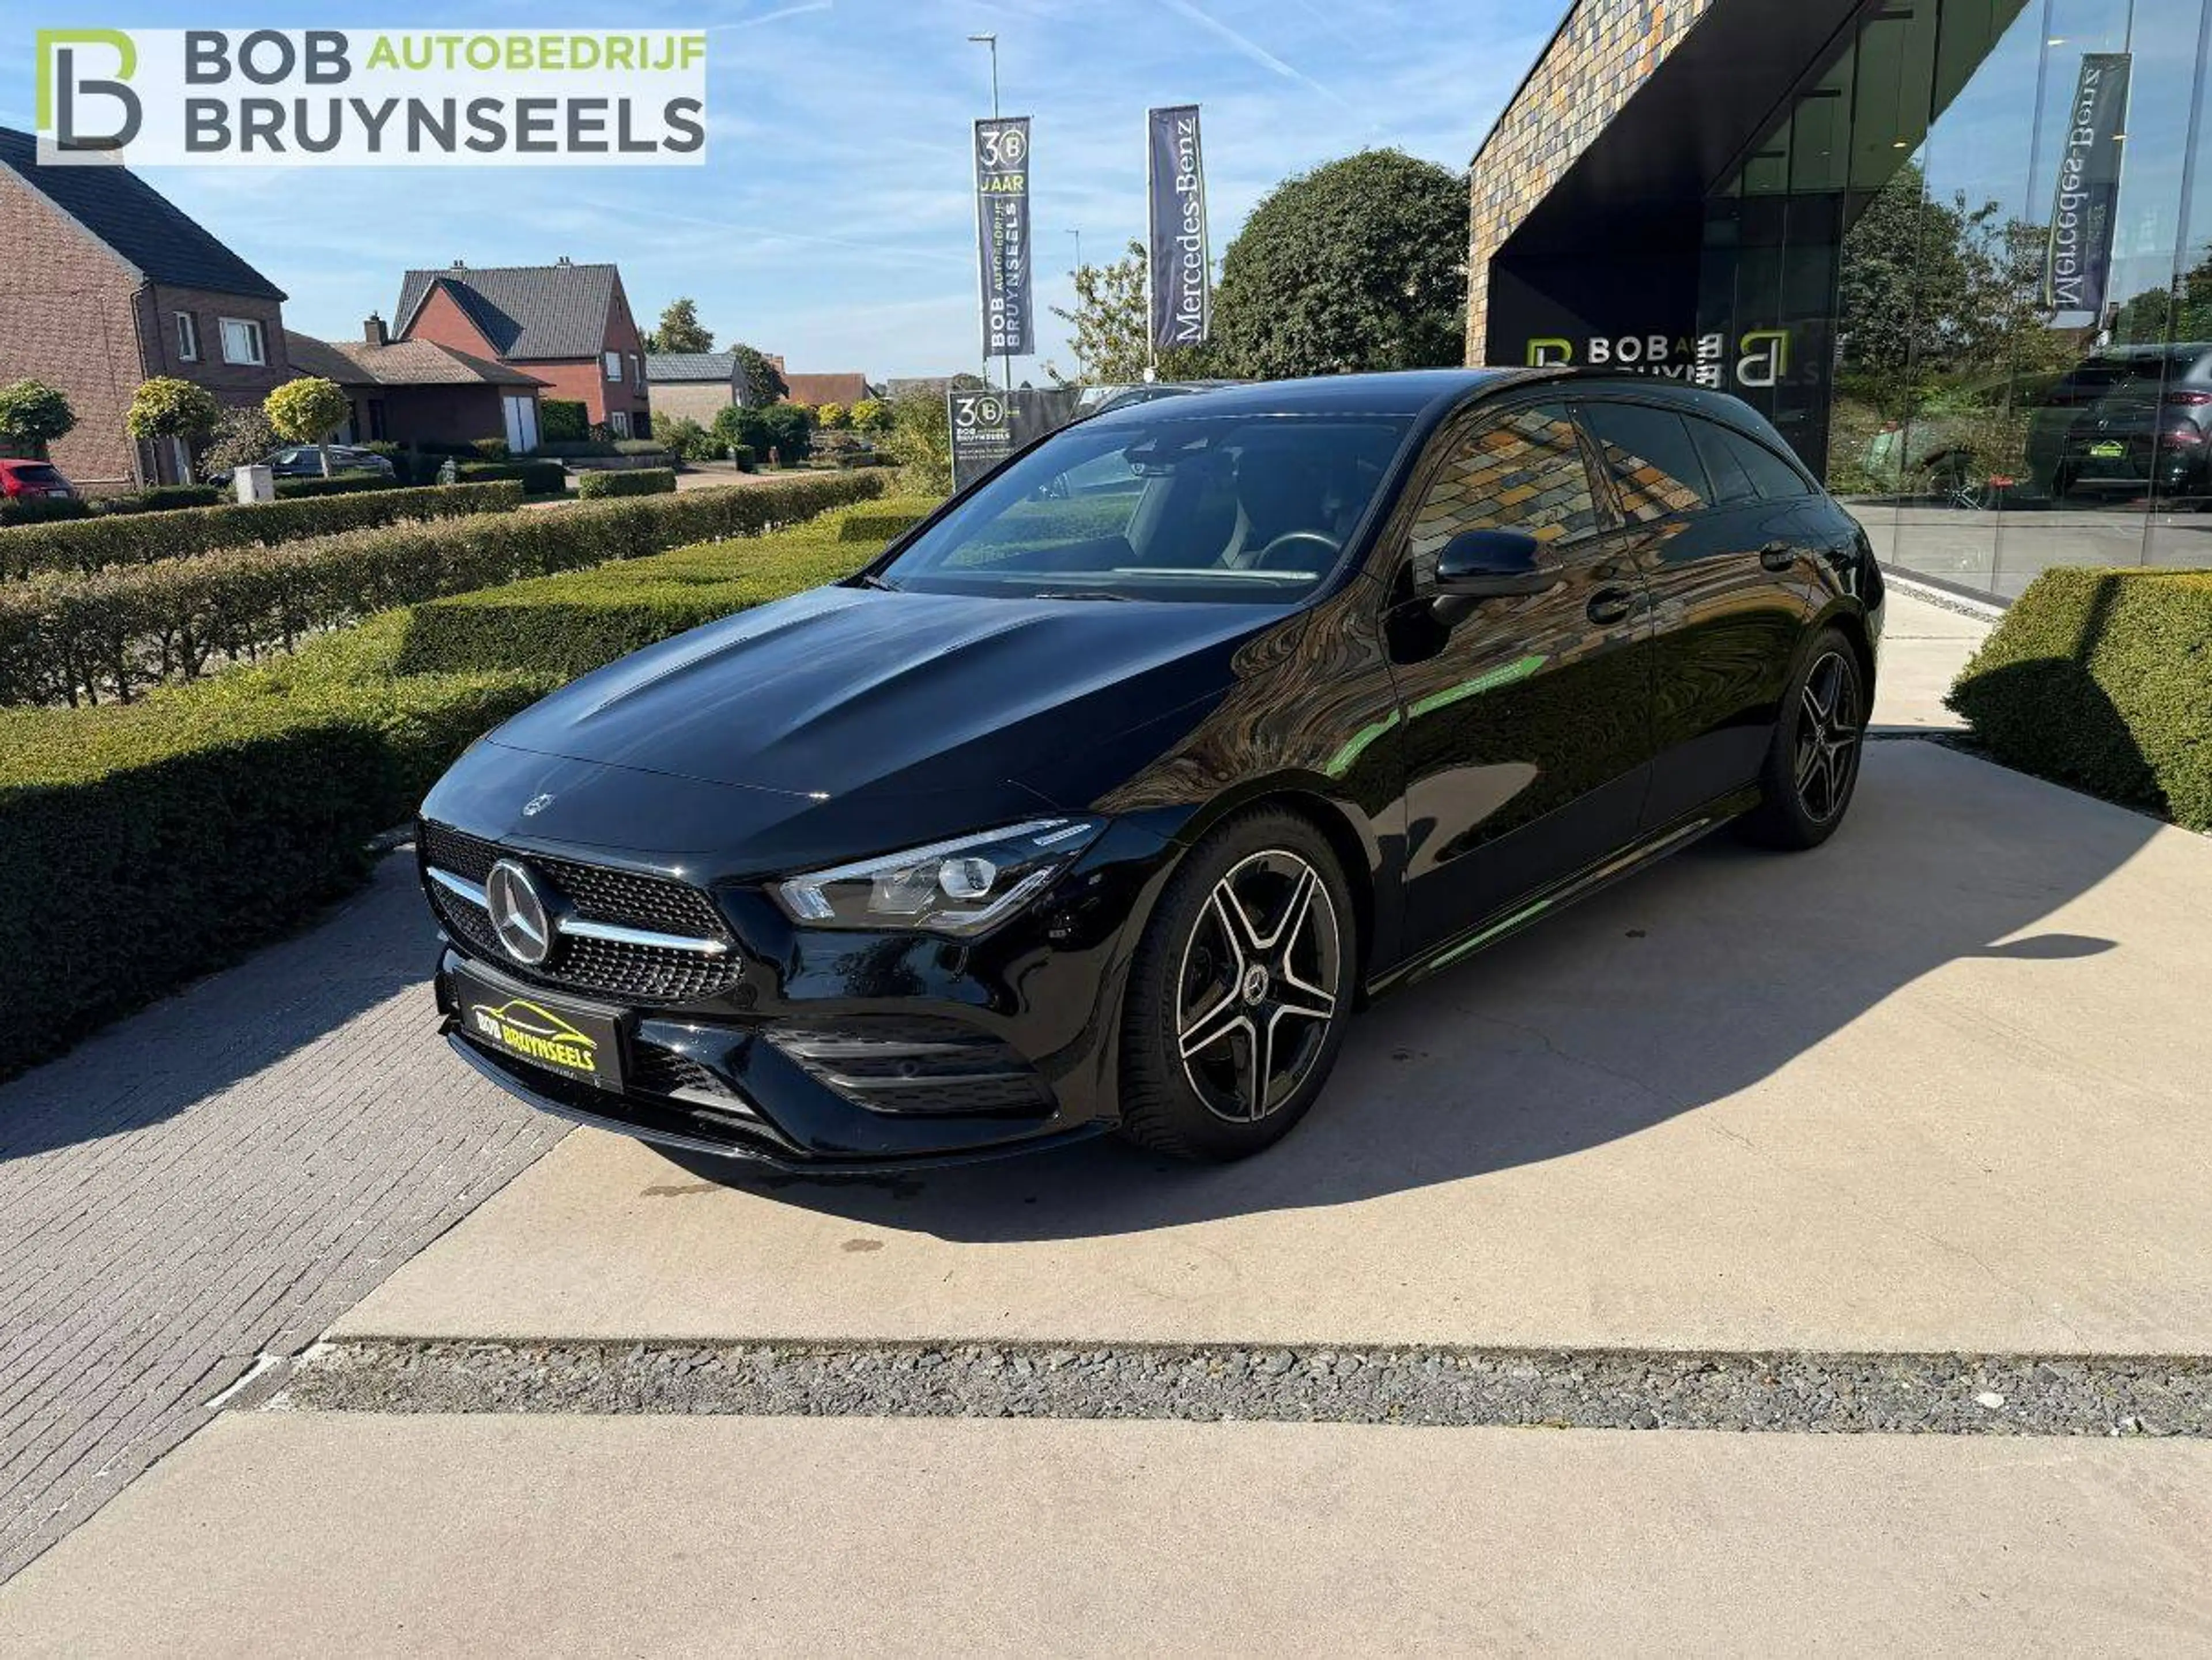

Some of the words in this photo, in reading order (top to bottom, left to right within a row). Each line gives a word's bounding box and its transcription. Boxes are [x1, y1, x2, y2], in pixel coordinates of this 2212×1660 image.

[980, 175, 1024, 193] JAAR
[1176, 117, 1201, 343] Mercedes-Benz
[1006, 202, 1020, 347] BRUYNSEELS
[991, 297, 1005, 348] BOB
[1588, 335, 1668, 363] BOB
[501, 1023, 595, 1072] BRUYNSEELS
